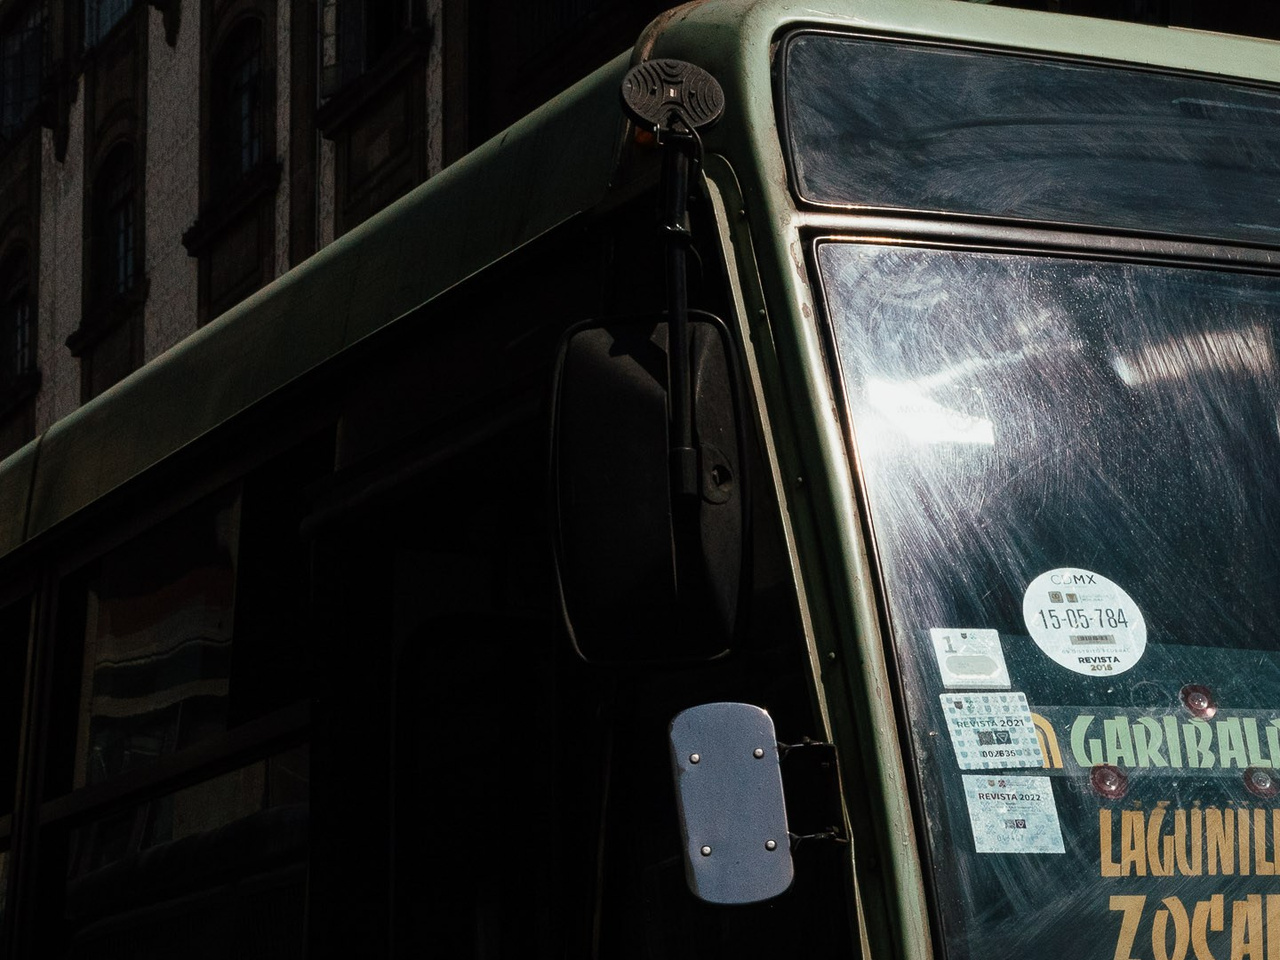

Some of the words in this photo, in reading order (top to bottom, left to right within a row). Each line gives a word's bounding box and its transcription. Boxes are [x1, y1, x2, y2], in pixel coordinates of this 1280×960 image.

[1050, 574, 1097, 586] CDMX
[1039, 608, 1128, 629] 15-05-784
[1078, 656, 1121, 664] REVISTA
[956, 720, 998, 729] REVISTA
[1000, 719, 1025, 727] 2021
[978, 792, 1018, 801] REVISTA
